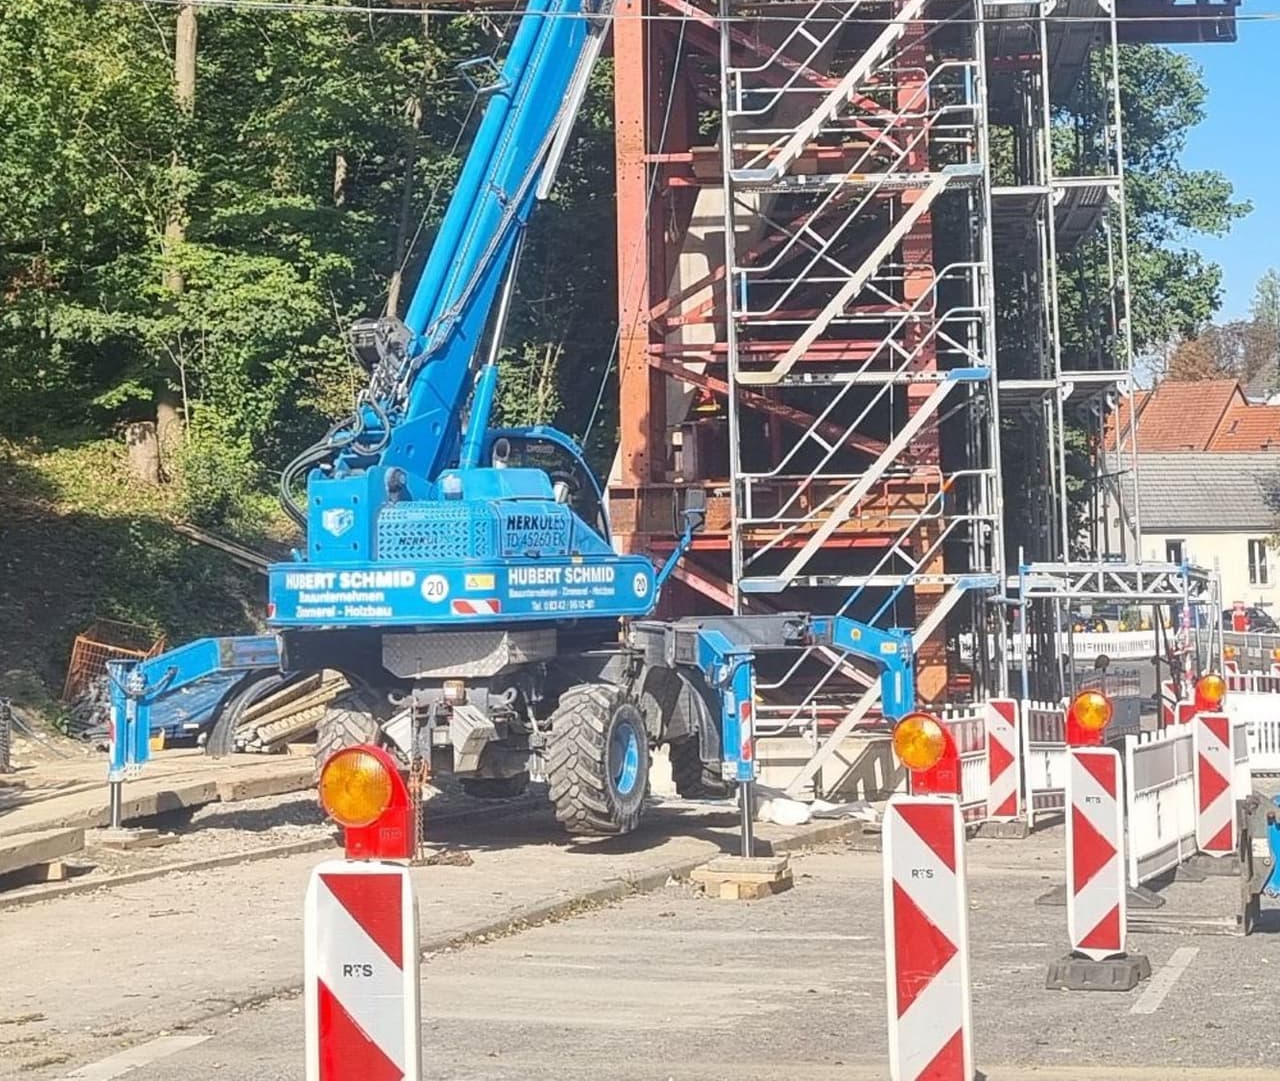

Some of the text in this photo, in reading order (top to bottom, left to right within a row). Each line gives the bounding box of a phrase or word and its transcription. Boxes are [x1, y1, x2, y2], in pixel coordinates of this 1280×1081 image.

[507, 515, 566, 531] HERKULES
[285, 570, 416, 590] HUBERT SCHMID
[508, 567, 615, 585] HUBERT SCHMID
[427, 581, 444, 596] 20
[911, 869, 934, 879] RTS
[342, 964, 373, 977] RTS
